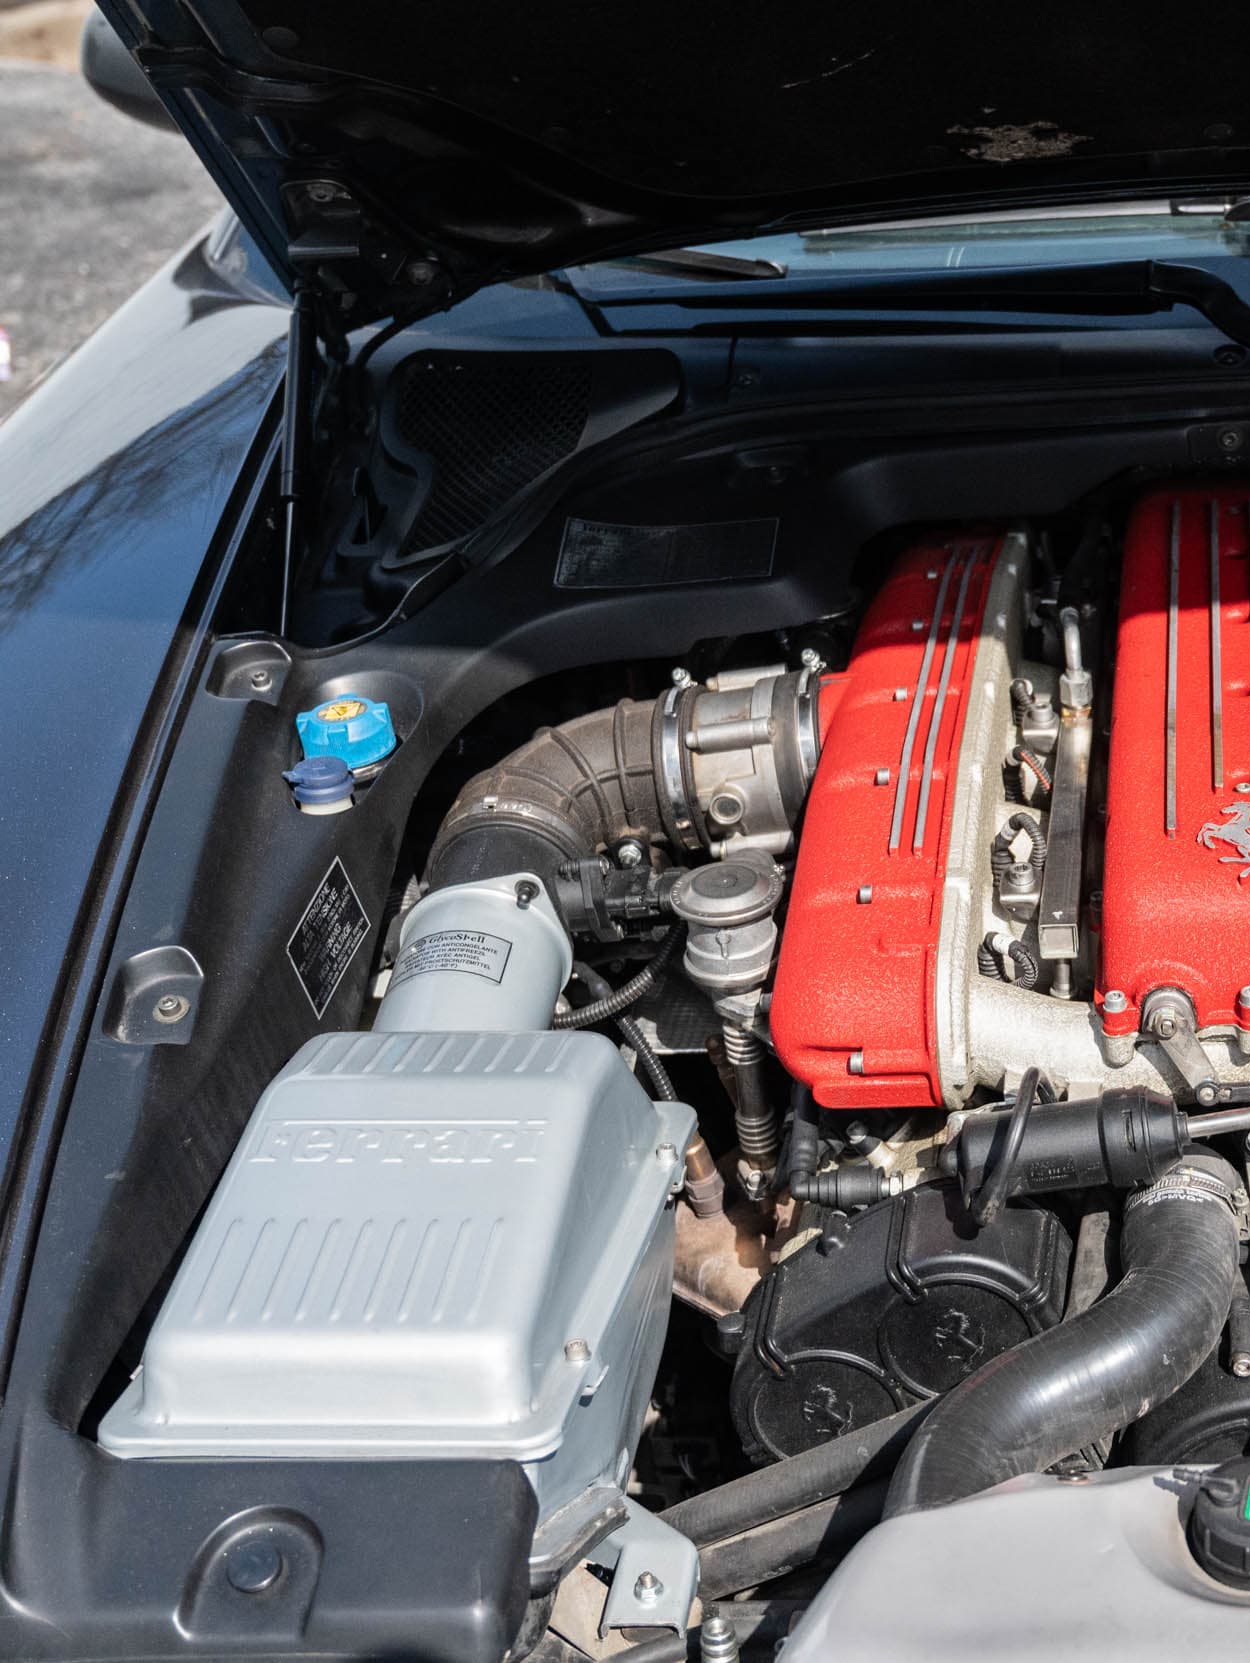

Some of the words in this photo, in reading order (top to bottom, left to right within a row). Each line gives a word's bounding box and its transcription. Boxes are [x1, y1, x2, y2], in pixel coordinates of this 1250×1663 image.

[302, 882, 331, 936] ATTENZIONE
[330, 921, 352, 959] VOLTAGE
[442, 942, 498, 955] ANTICONGELANTE
[447, 947, 486, 957] ANTIFREEZE
[249, 1118, 549, 1163] Ferrari
